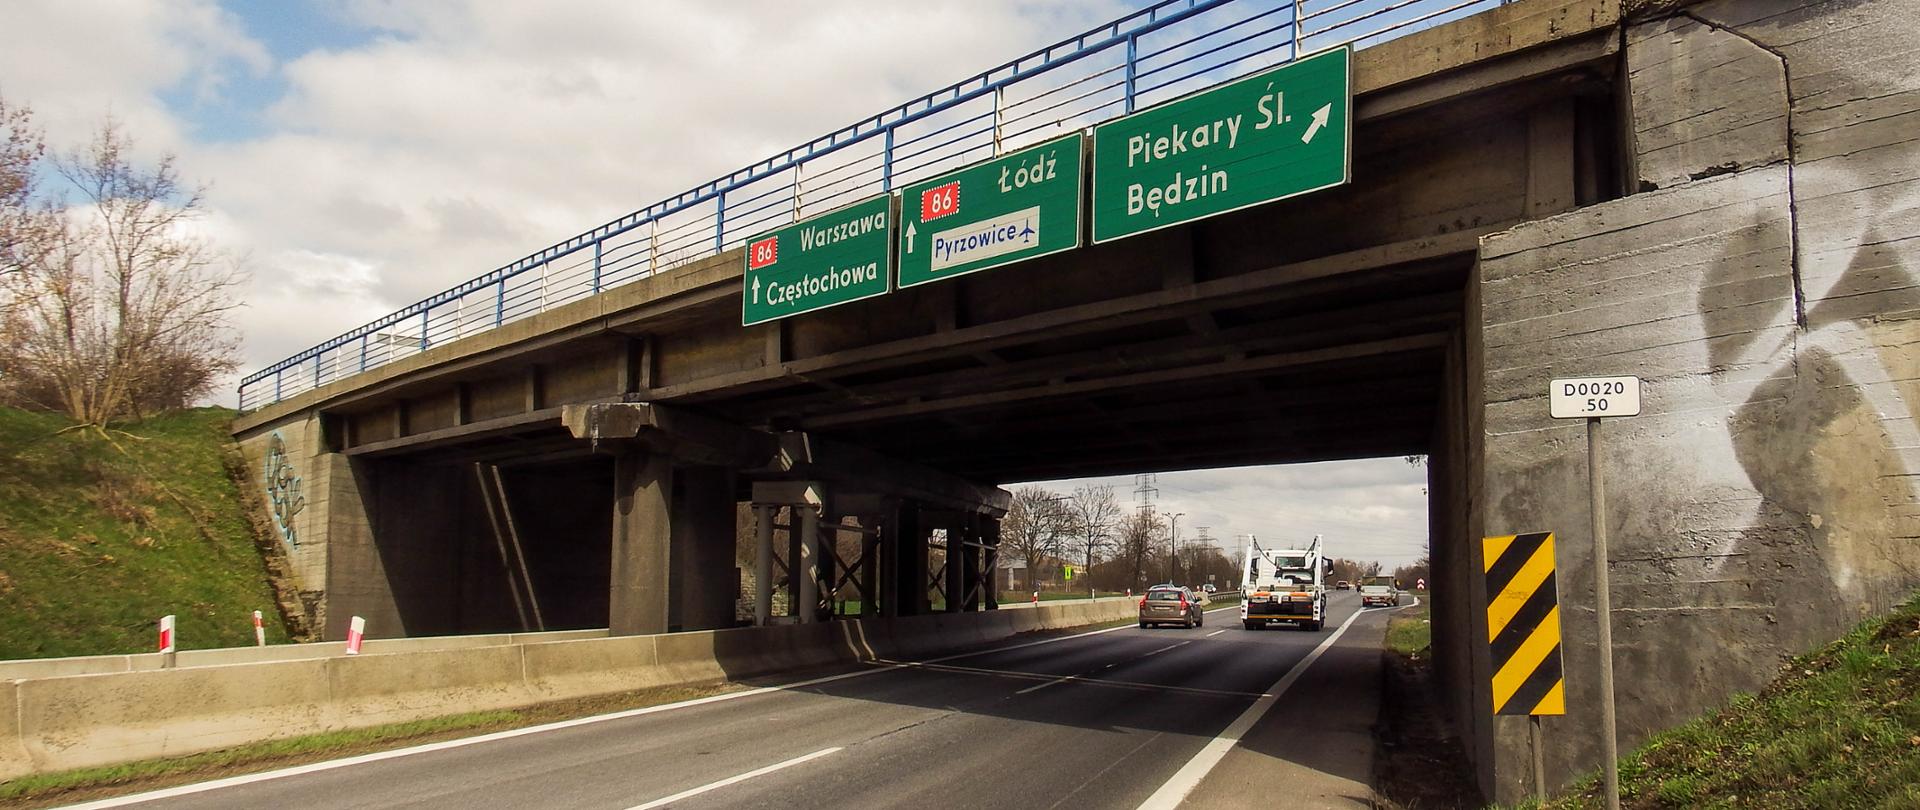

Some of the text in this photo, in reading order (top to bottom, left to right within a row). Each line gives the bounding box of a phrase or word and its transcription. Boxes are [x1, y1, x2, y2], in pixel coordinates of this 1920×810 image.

[1128, 82, 1291, 167] Piekary Śl.
[998, 150, 1056, 193] Łódź
[931, 189, 952, 213] 86
[1128, 164, 1228, 218] Będzin
[800, 211, 885, 251] Warszawa
[935, 224, 1016, 261] Pyrzowice
[757, 243, 772, 263] 86
[766, 262, 877, 306] Częstochowa
[1564, 382, 1624, 396] D0020
[1581, 398, 1608, 412] .50
